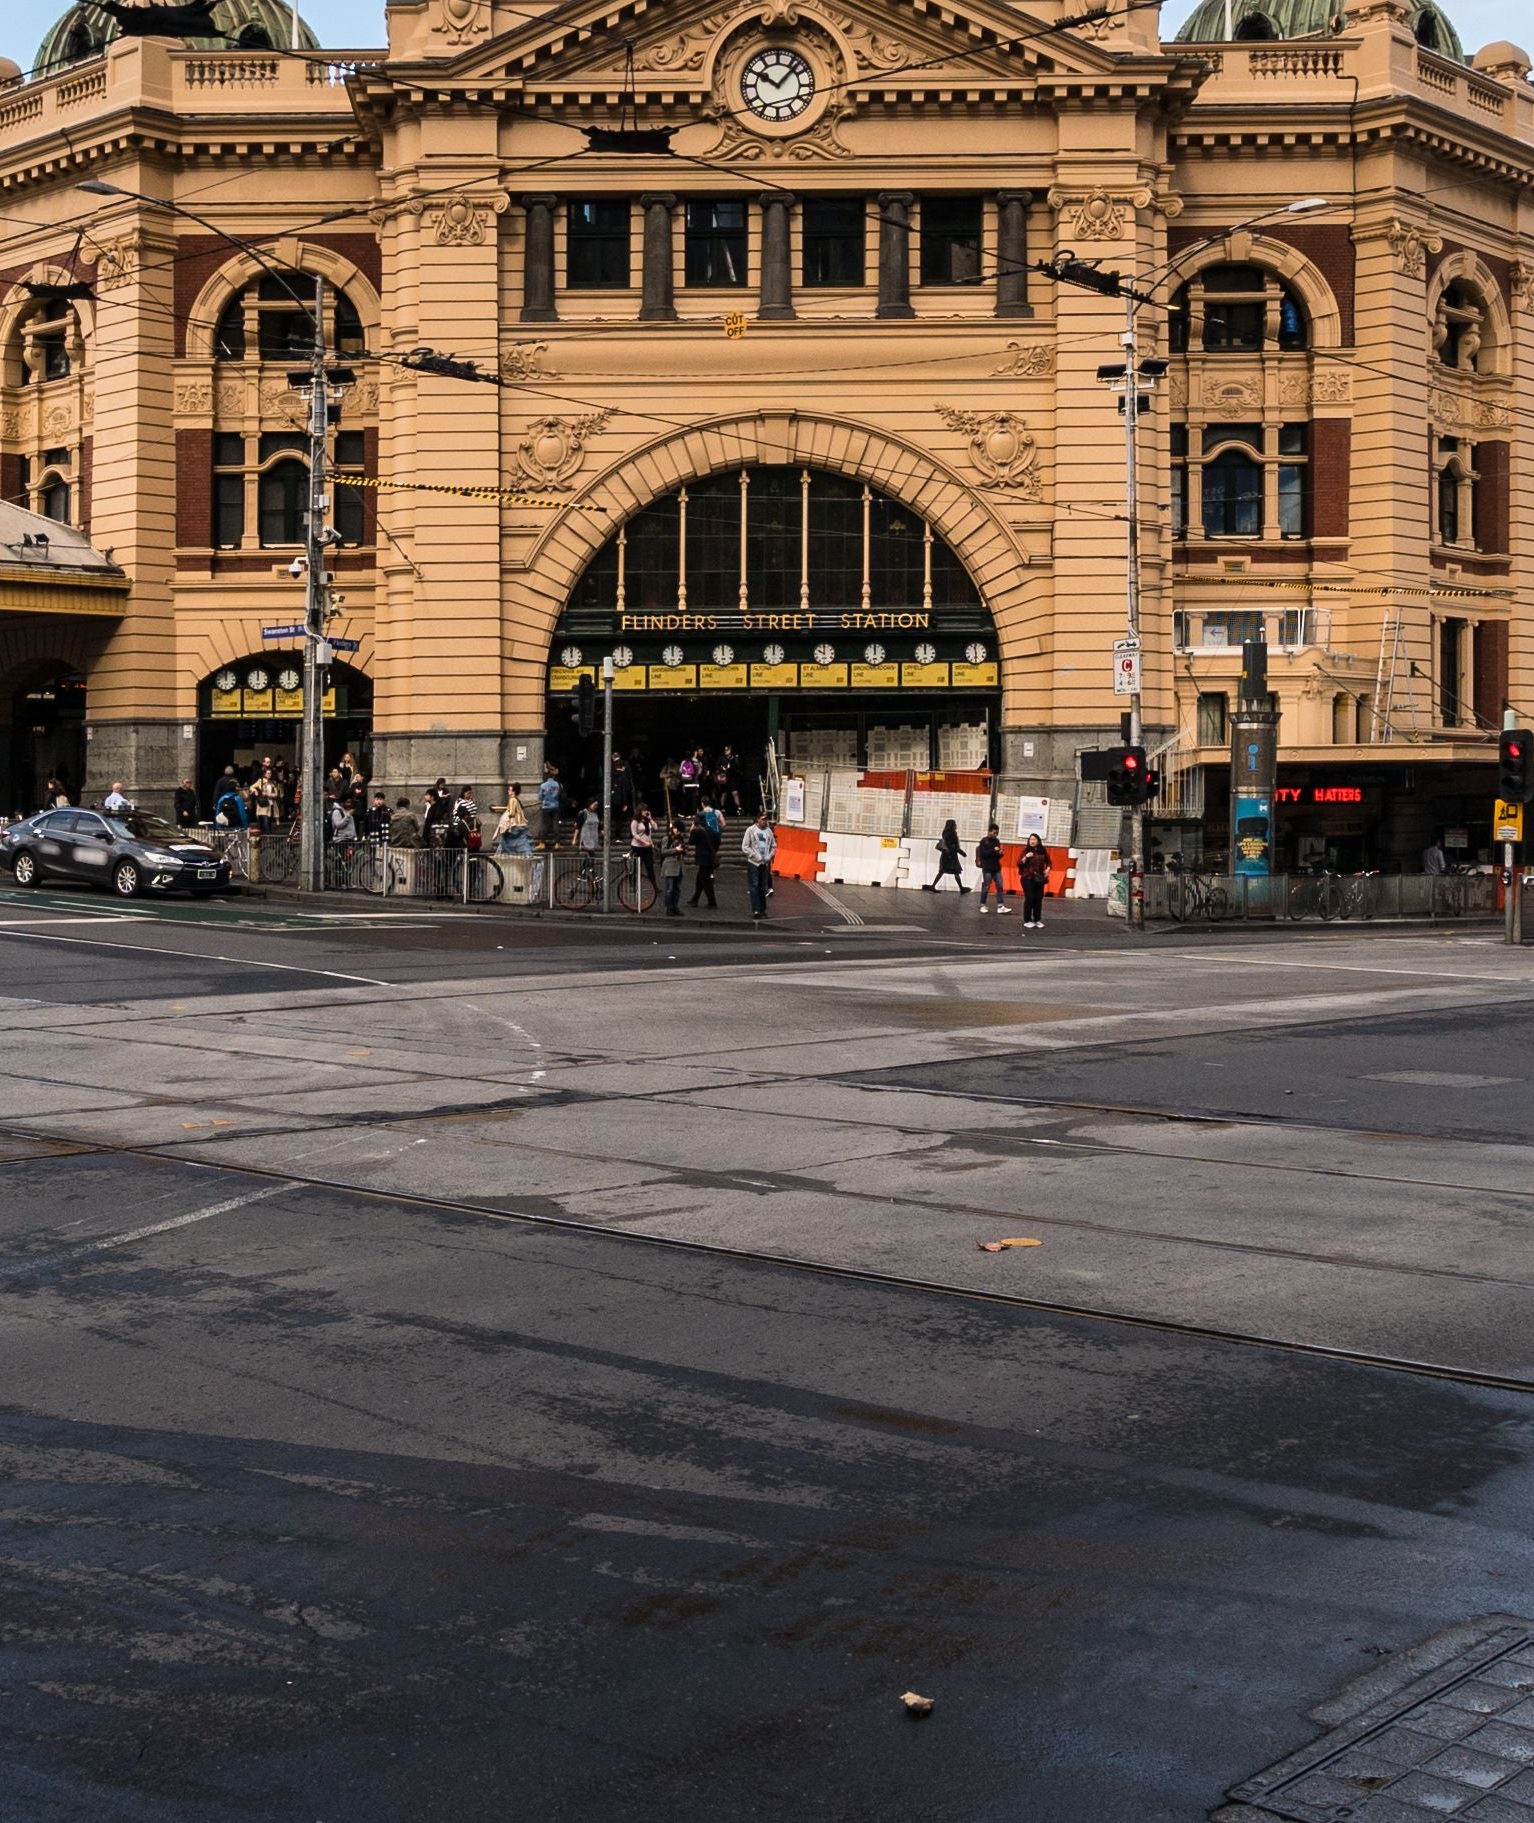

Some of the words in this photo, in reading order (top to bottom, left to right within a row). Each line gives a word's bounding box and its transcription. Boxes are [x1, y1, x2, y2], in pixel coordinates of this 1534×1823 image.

[622, 614, 717, 630] FLINDERS
[743, 613, 815, 630] STREET
[841, 613, 929, 629] STATION
[1274, 788, 1301, 803] ITY
[1314, 788, 1361, 802] HATTERS
